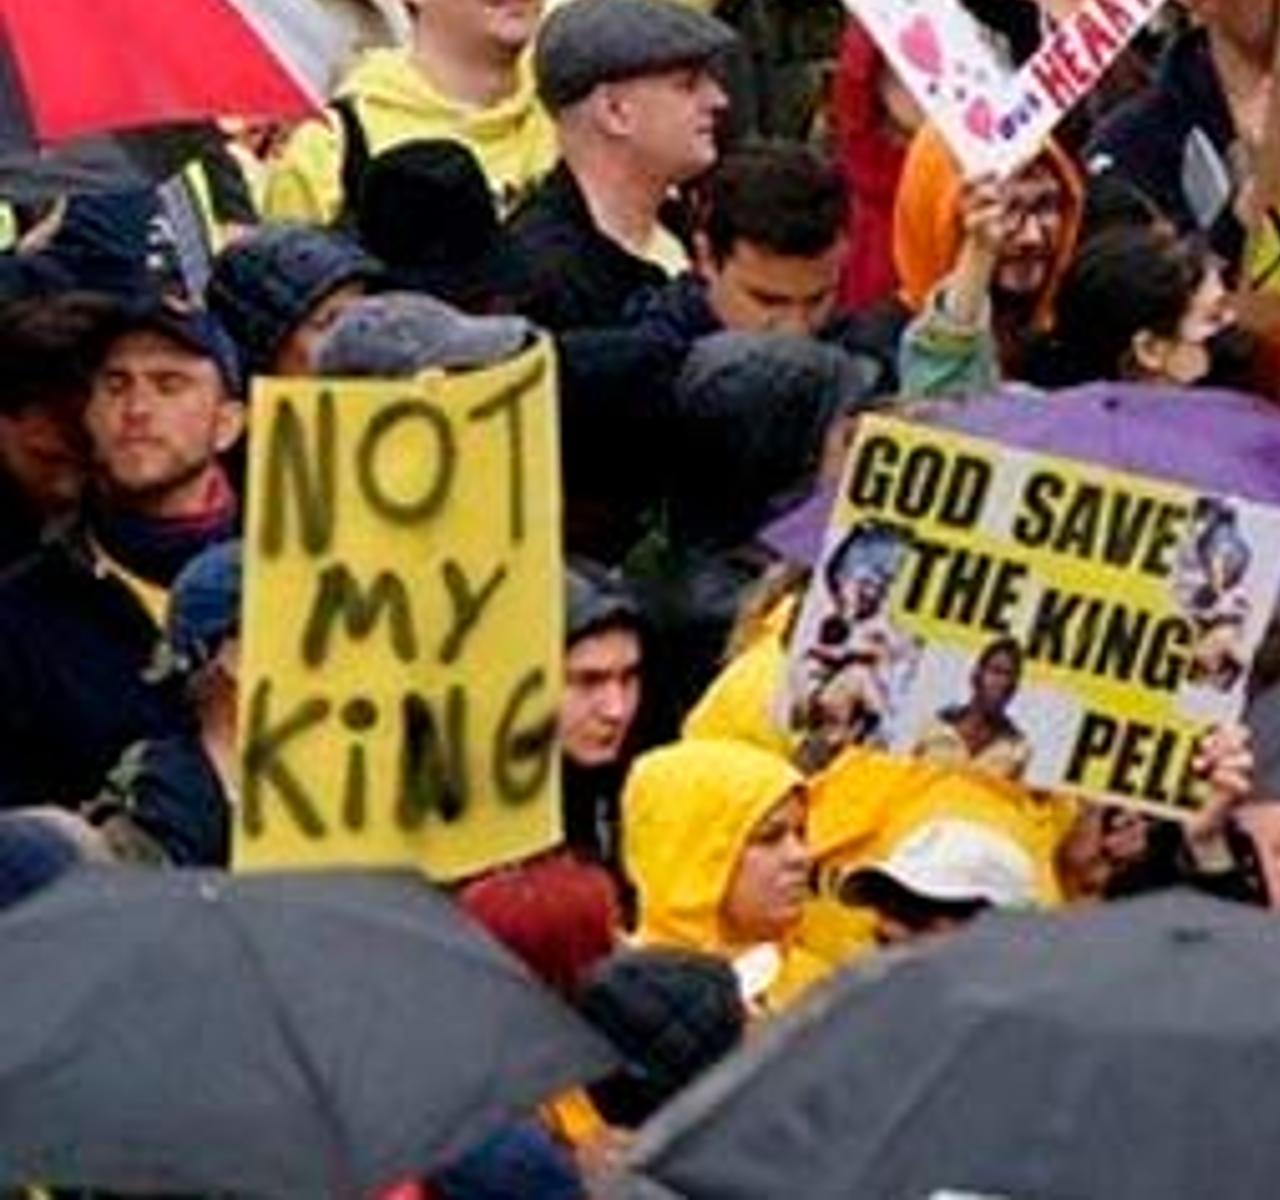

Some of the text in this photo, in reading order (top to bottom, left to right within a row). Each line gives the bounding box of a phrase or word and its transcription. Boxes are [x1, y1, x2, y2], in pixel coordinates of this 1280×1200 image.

[261, 356, 548, 558] NOT
[847, 435, 1188, 577] GOD SAVE
[303, 560, 507, 668] MY
[900, 537, 1193, 693] THE KING
[241, 668, 561, 839] KiNG
